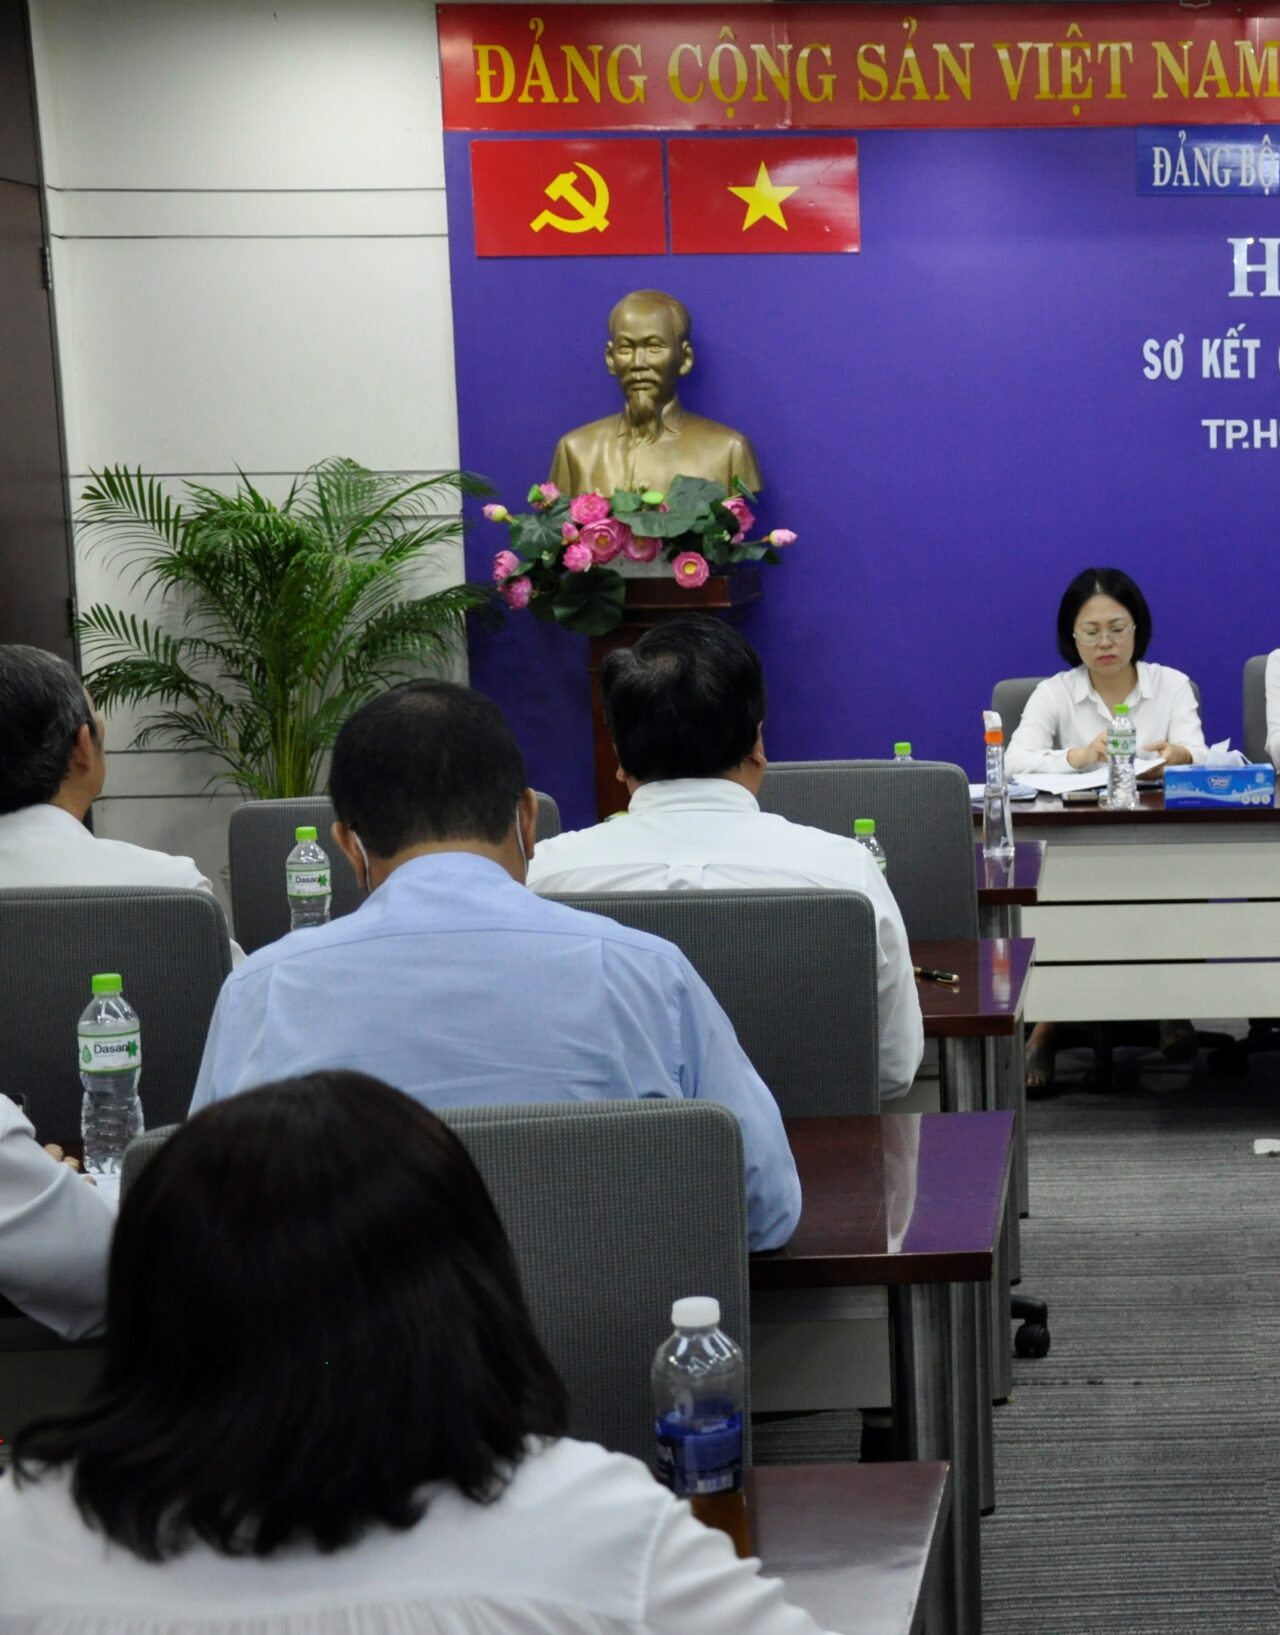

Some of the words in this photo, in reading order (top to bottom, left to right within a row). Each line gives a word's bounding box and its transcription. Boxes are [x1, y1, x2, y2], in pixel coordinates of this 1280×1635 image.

[473, 18, 648, 104] ĐẢNG
[667, 25, 837, 119] CỘNG
[857, 17, 975, 102] SẢN
[992, 23, 1134, 116] VIỆT
[1152, 130, 1233, 187] ĐẢNG
[1239, 134, 1277, 195] BỘ
[1142, 333, 1185, 380] SƠ
[1202, 323, 1261, 379] KẾT
